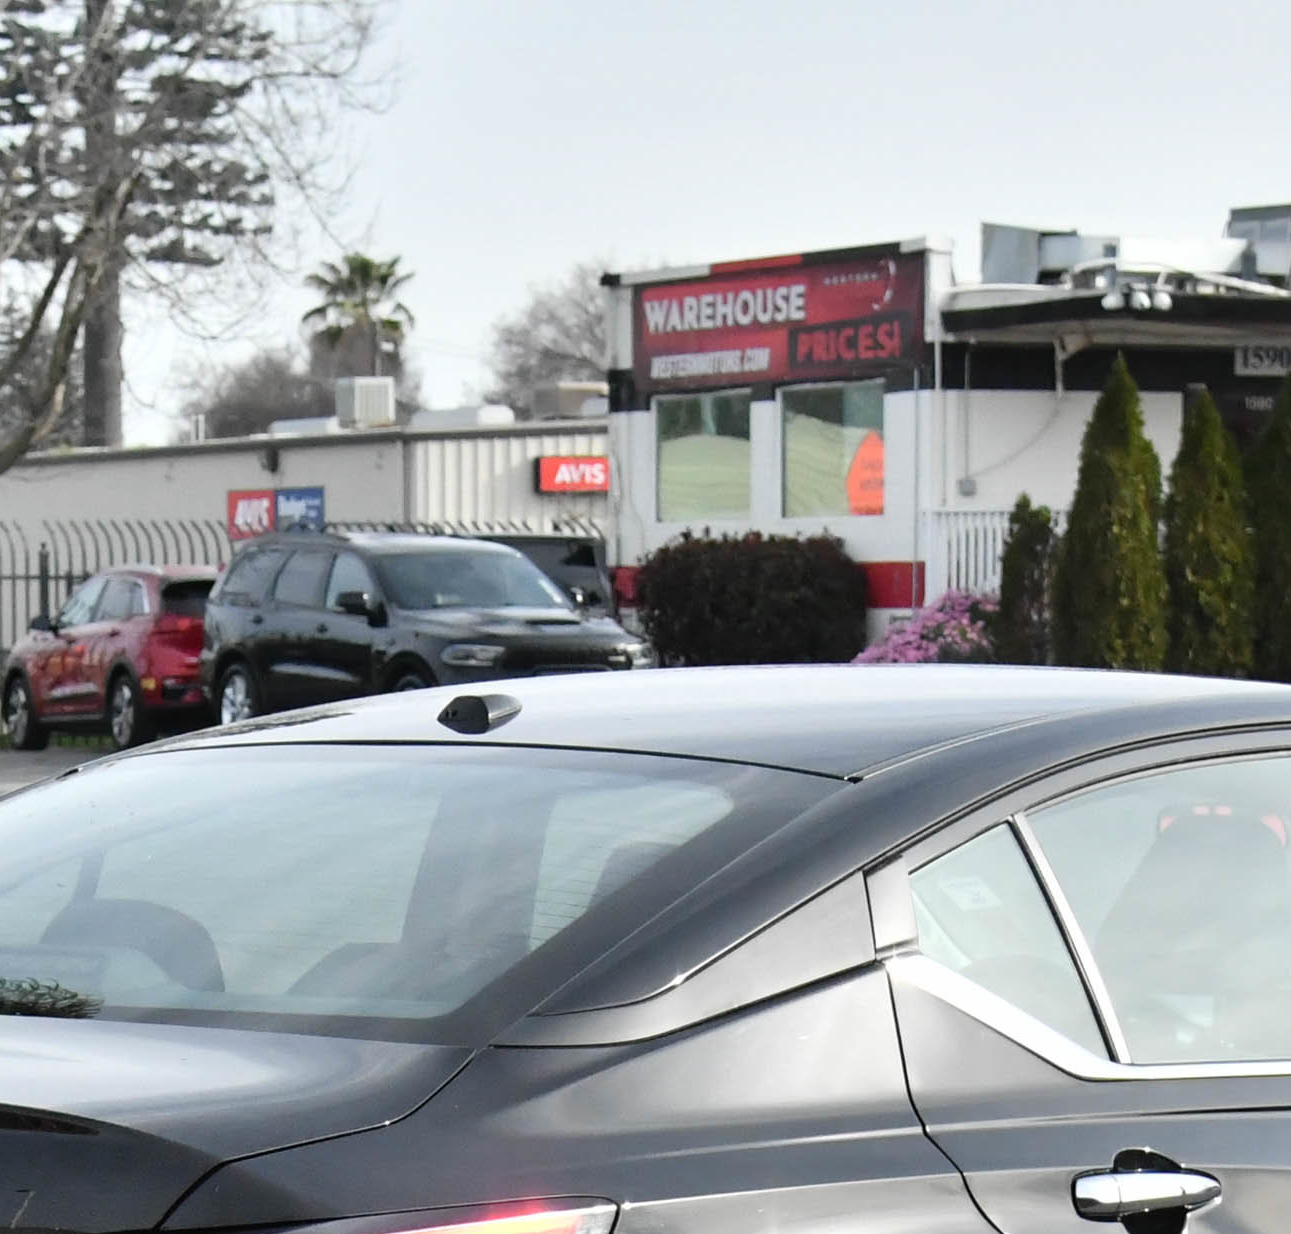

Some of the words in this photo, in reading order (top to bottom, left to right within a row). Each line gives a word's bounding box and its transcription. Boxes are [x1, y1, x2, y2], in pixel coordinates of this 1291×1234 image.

[644, 284, 806, 334] WAREHOUSE
[796, 320, 902, 363] PRICES!
[554, 463, 607, 486] AVIS
